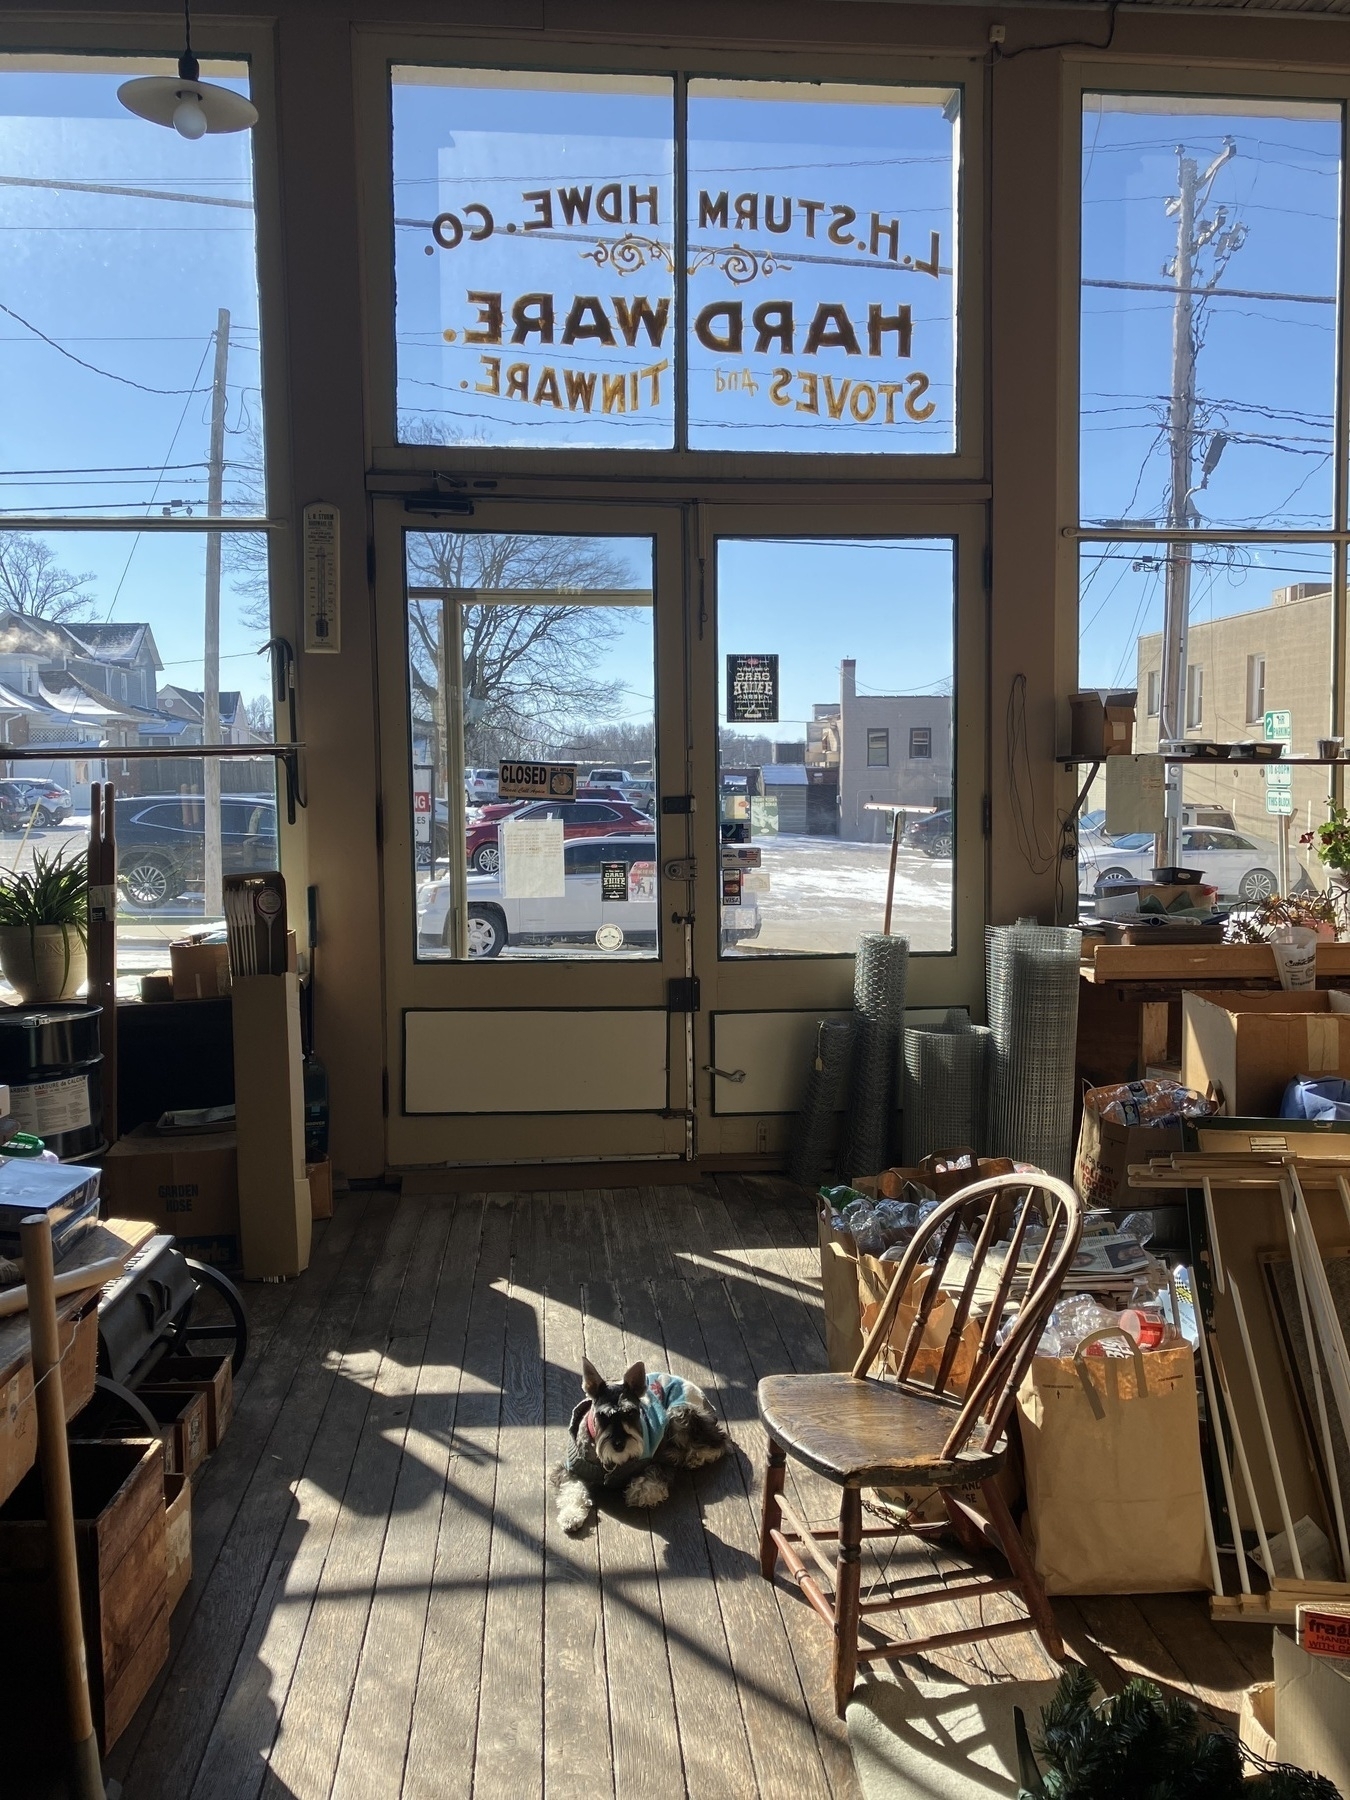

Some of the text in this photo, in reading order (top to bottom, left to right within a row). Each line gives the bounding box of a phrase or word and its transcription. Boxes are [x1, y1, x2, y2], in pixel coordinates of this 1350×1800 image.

[1266, 717, 1273, 736] 2
[1273, 727, 1291, 737] PARKING
[501, 765, 547, 785] CLOSED
[1268, 797, 1290, 807] THIS BLOCK
[1081, 1161, 1119, 1189] HOLIDAY
[158, 1184, 199, 1198] GARDEN
[1083, 1173, 1112, 1196] FOODS
[166, 1199, 193, 1213] HOSE
[1309, 1640, 1335, 1650] WITH
